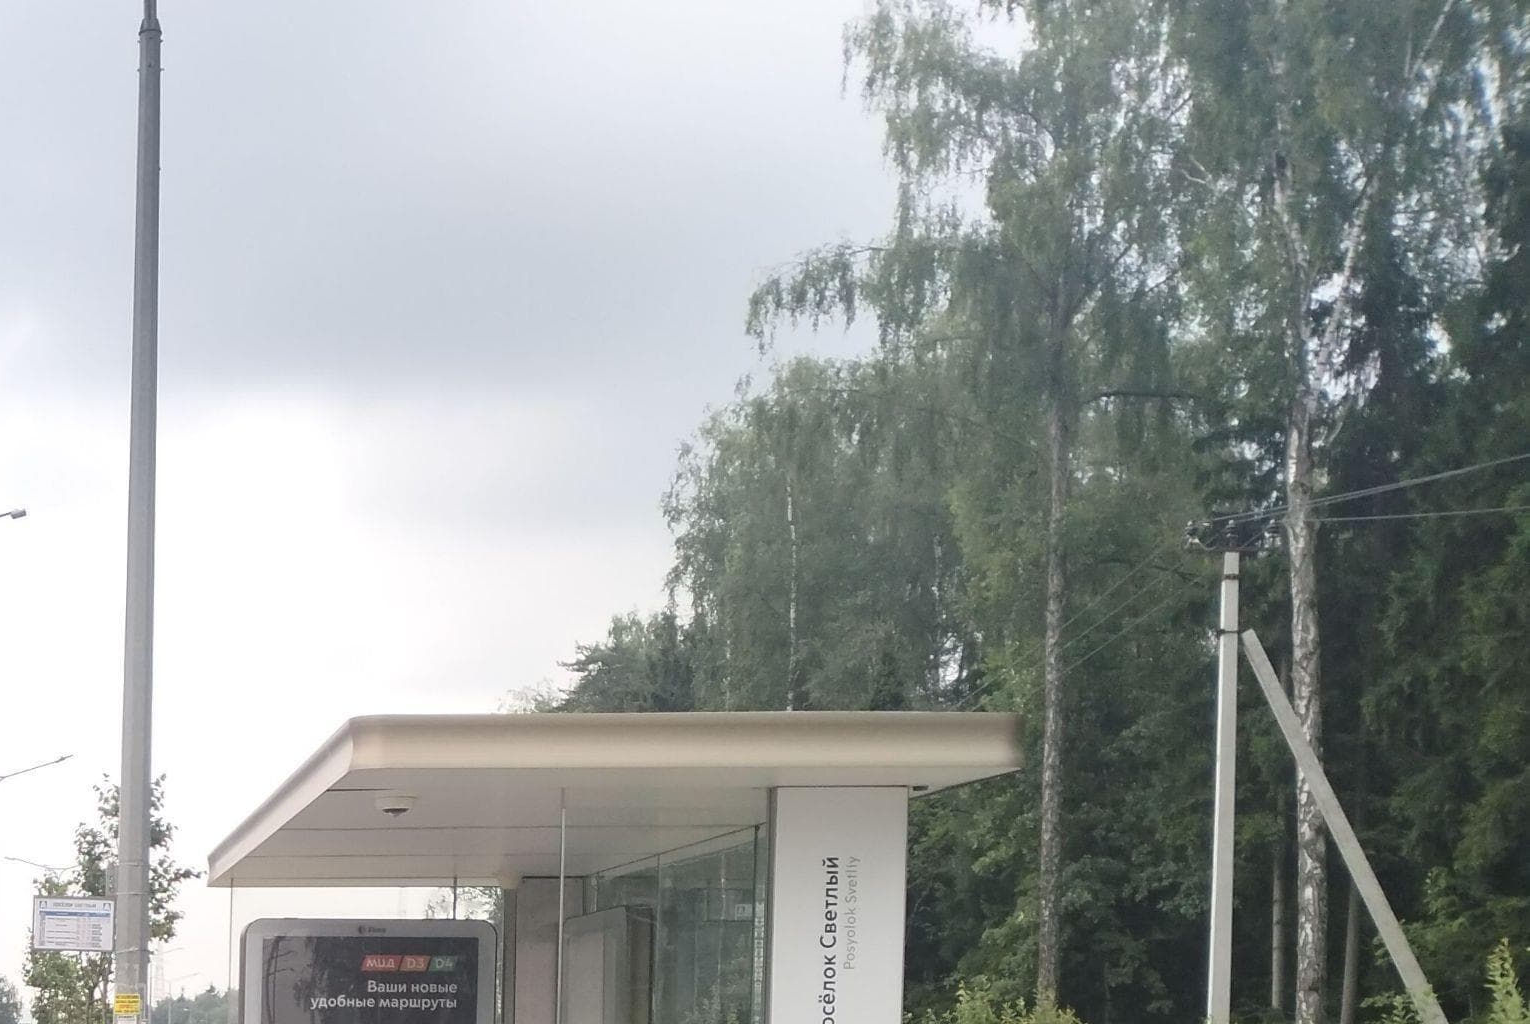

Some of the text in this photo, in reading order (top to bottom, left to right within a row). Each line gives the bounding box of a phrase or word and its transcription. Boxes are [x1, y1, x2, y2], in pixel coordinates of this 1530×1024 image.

[820, 856, 839, 949] Светлый
[843, 907, 859, 970] Posyolok
[407, 958, 454, 969] D3 D4
[367, 980, 458, 993] Ваши новые
[310, 995, 457, 1011] удобные маршруты
